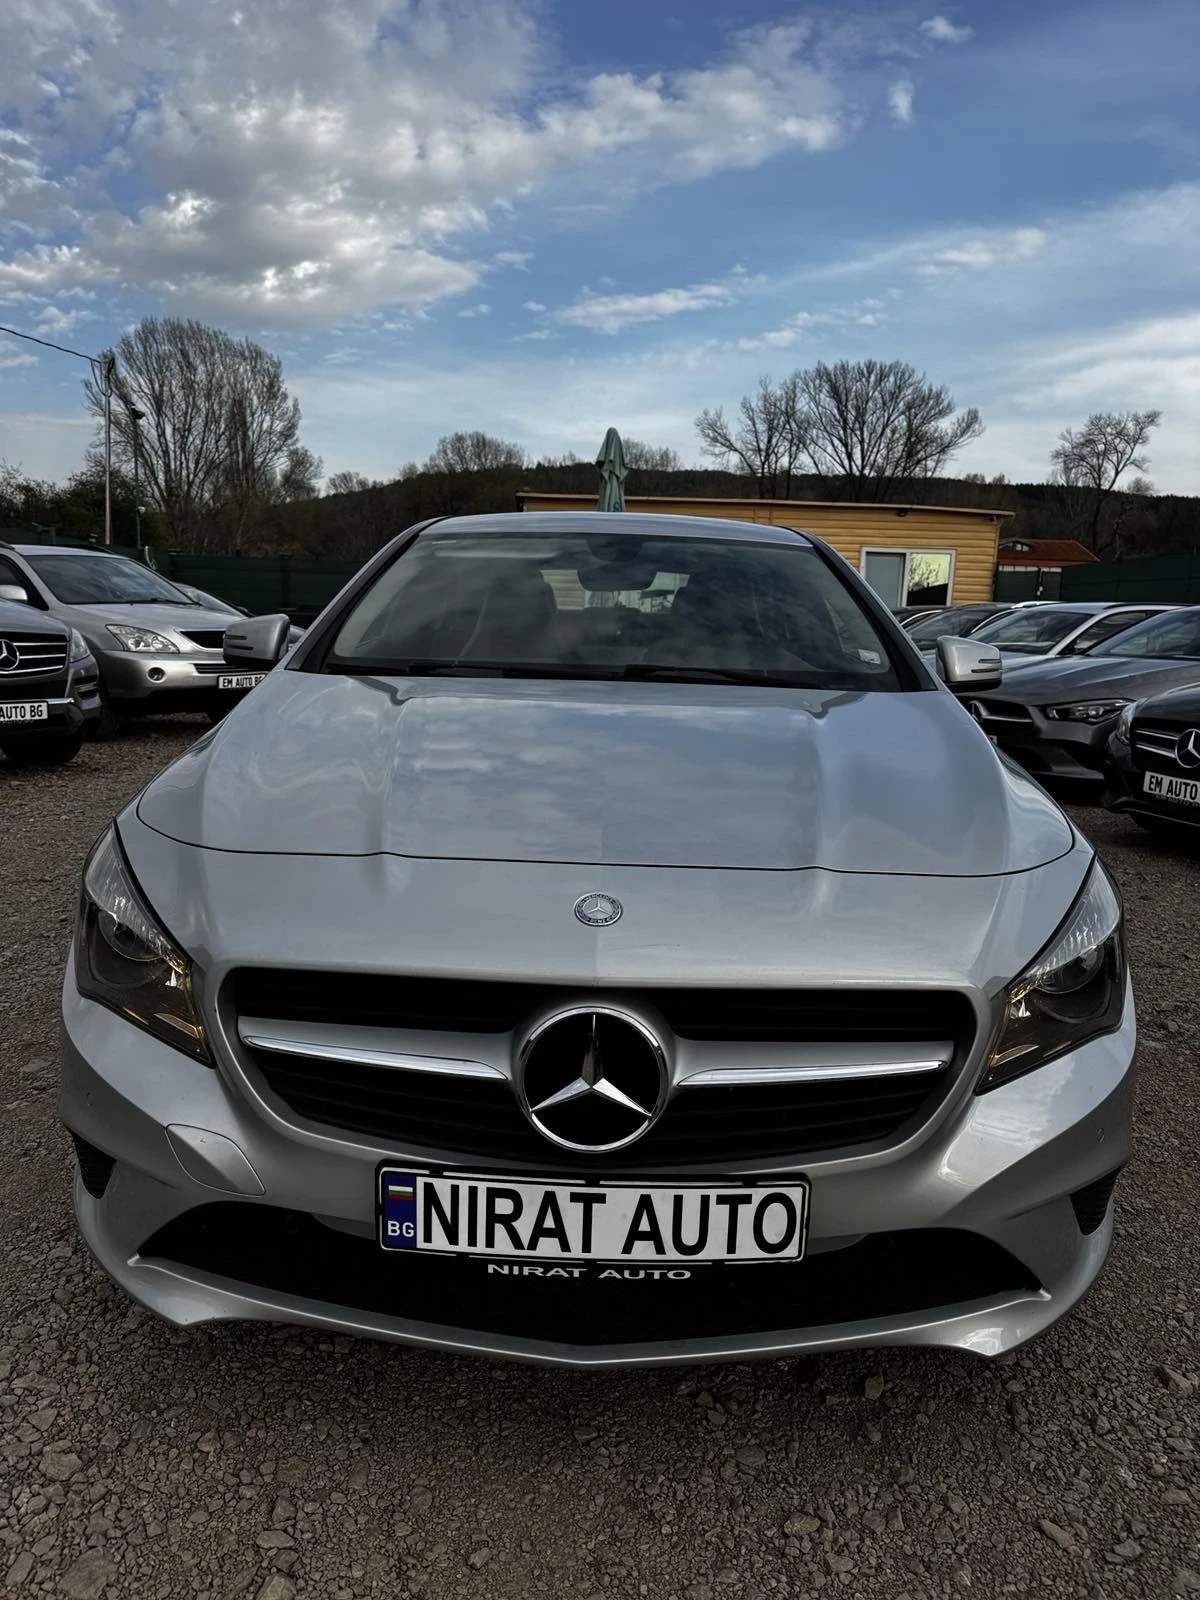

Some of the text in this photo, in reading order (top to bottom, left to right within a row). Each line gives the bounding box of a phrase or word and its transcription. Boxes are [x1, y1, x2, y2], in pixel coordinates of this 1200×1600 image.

[223, 677, 233, 688] EM
[236, 676, 253, 688] AUTO
[30, 704, 43, 717] BG
[1148, 775, 1198, 800] EM AUTO
[387, 1181, 798, 1256] BG NIRAT AUTO
[487, 1264, 692, 1280] NIRAT AUTO
